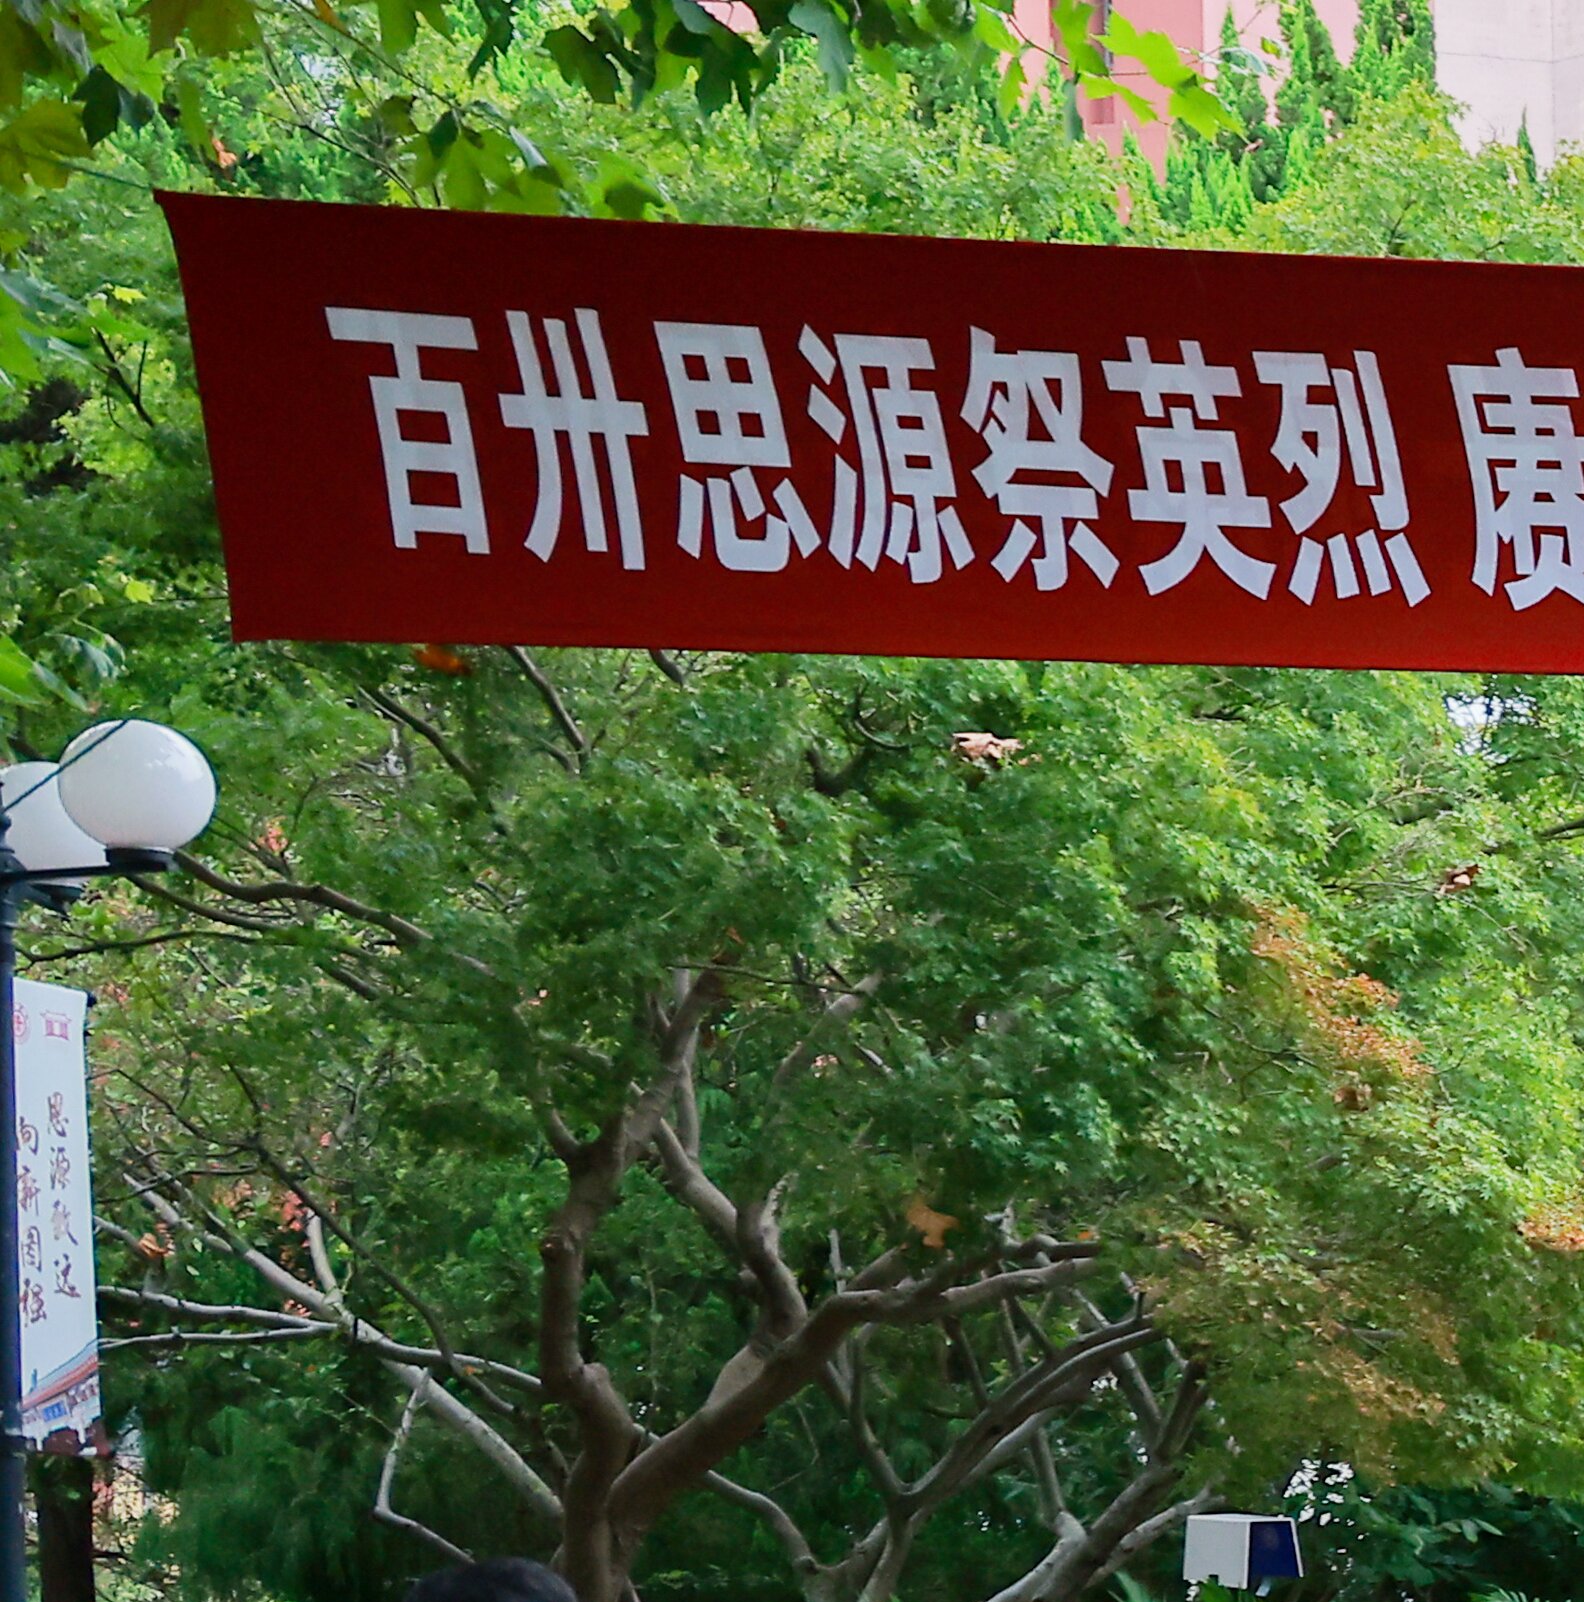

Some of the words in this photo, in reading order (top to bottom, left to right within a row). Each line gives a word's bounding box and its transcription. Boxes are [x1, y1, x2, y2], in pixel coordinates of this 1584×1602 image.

[326, 306, 1431, 608] 百卅思源祭英烈
